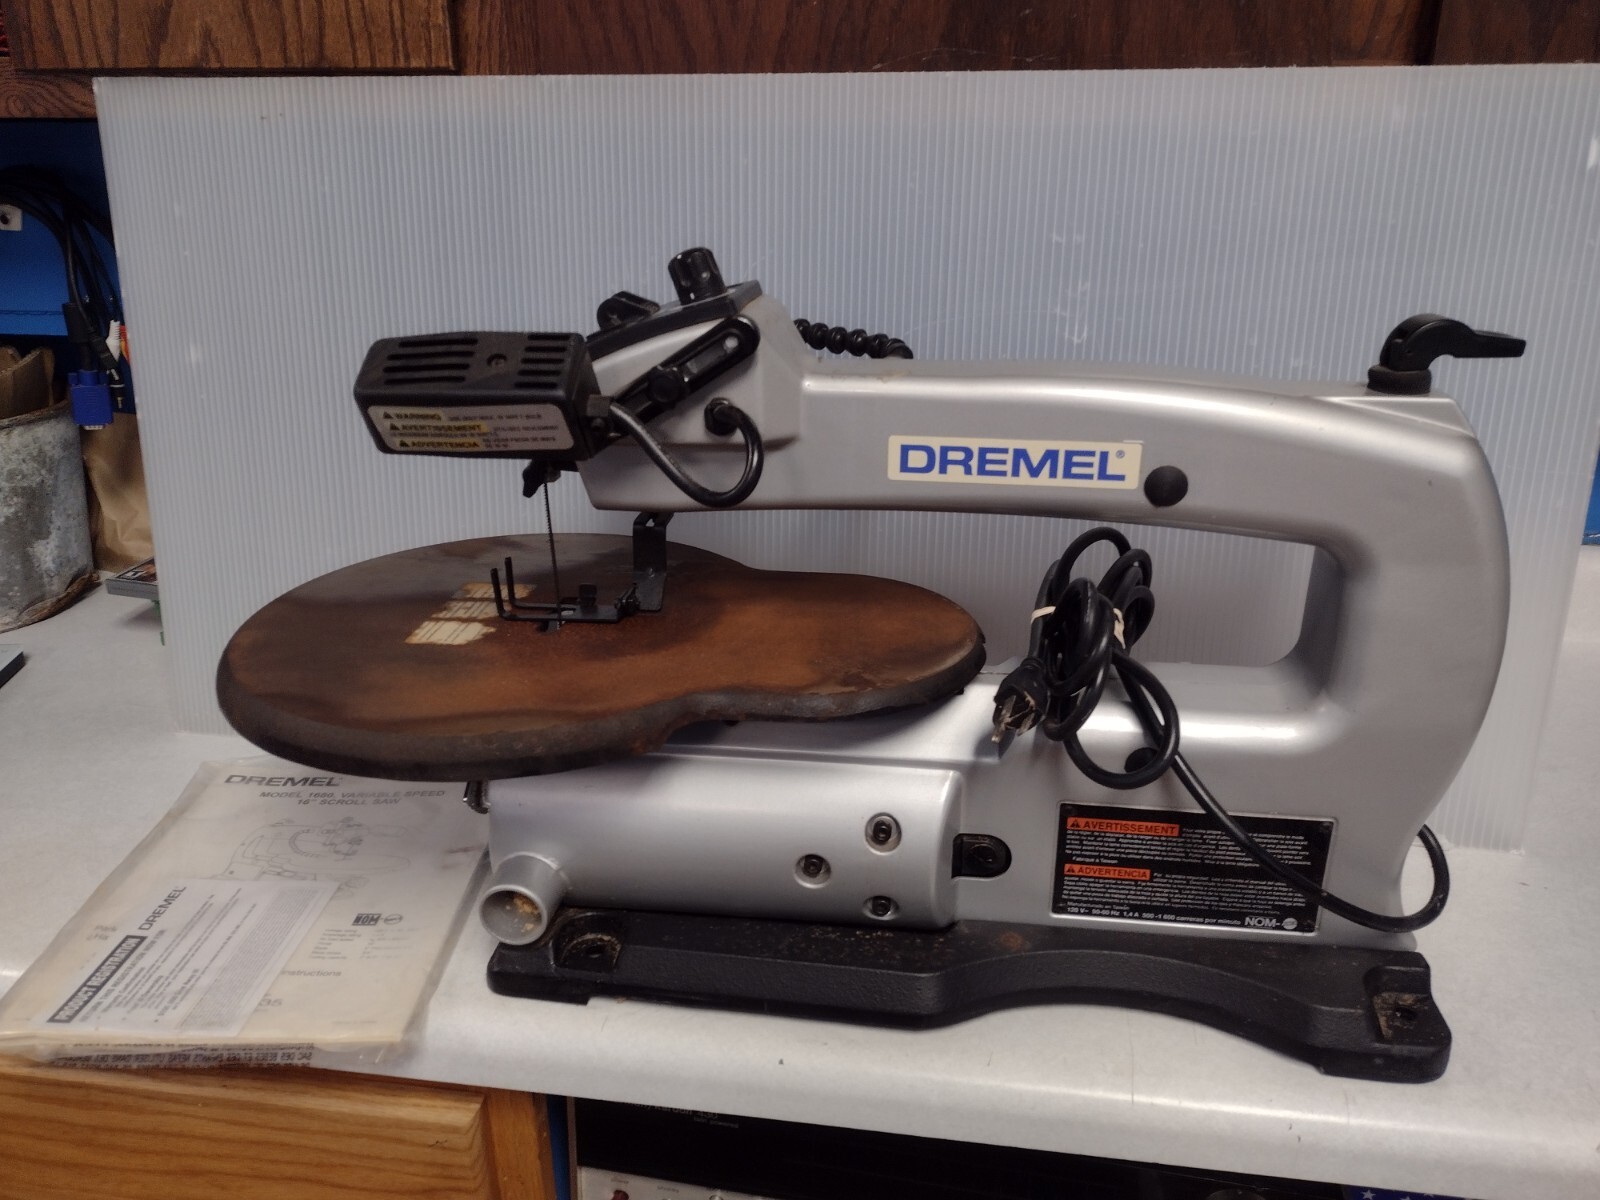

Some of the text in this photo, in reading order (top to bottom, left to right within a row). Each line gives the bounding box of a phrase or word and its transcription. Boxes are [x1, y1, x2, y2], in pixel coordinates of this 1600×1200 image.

[1083, 820, 1176, 835] AVERTISSEMENT
[1078, 867, 1148, 879] ADVERTENCIA
[138, 887, 186, 931] DREMEL
[53, 987, 97, 1019] PRODUCT
[85, 937, 141, 985] REGISTRATION
